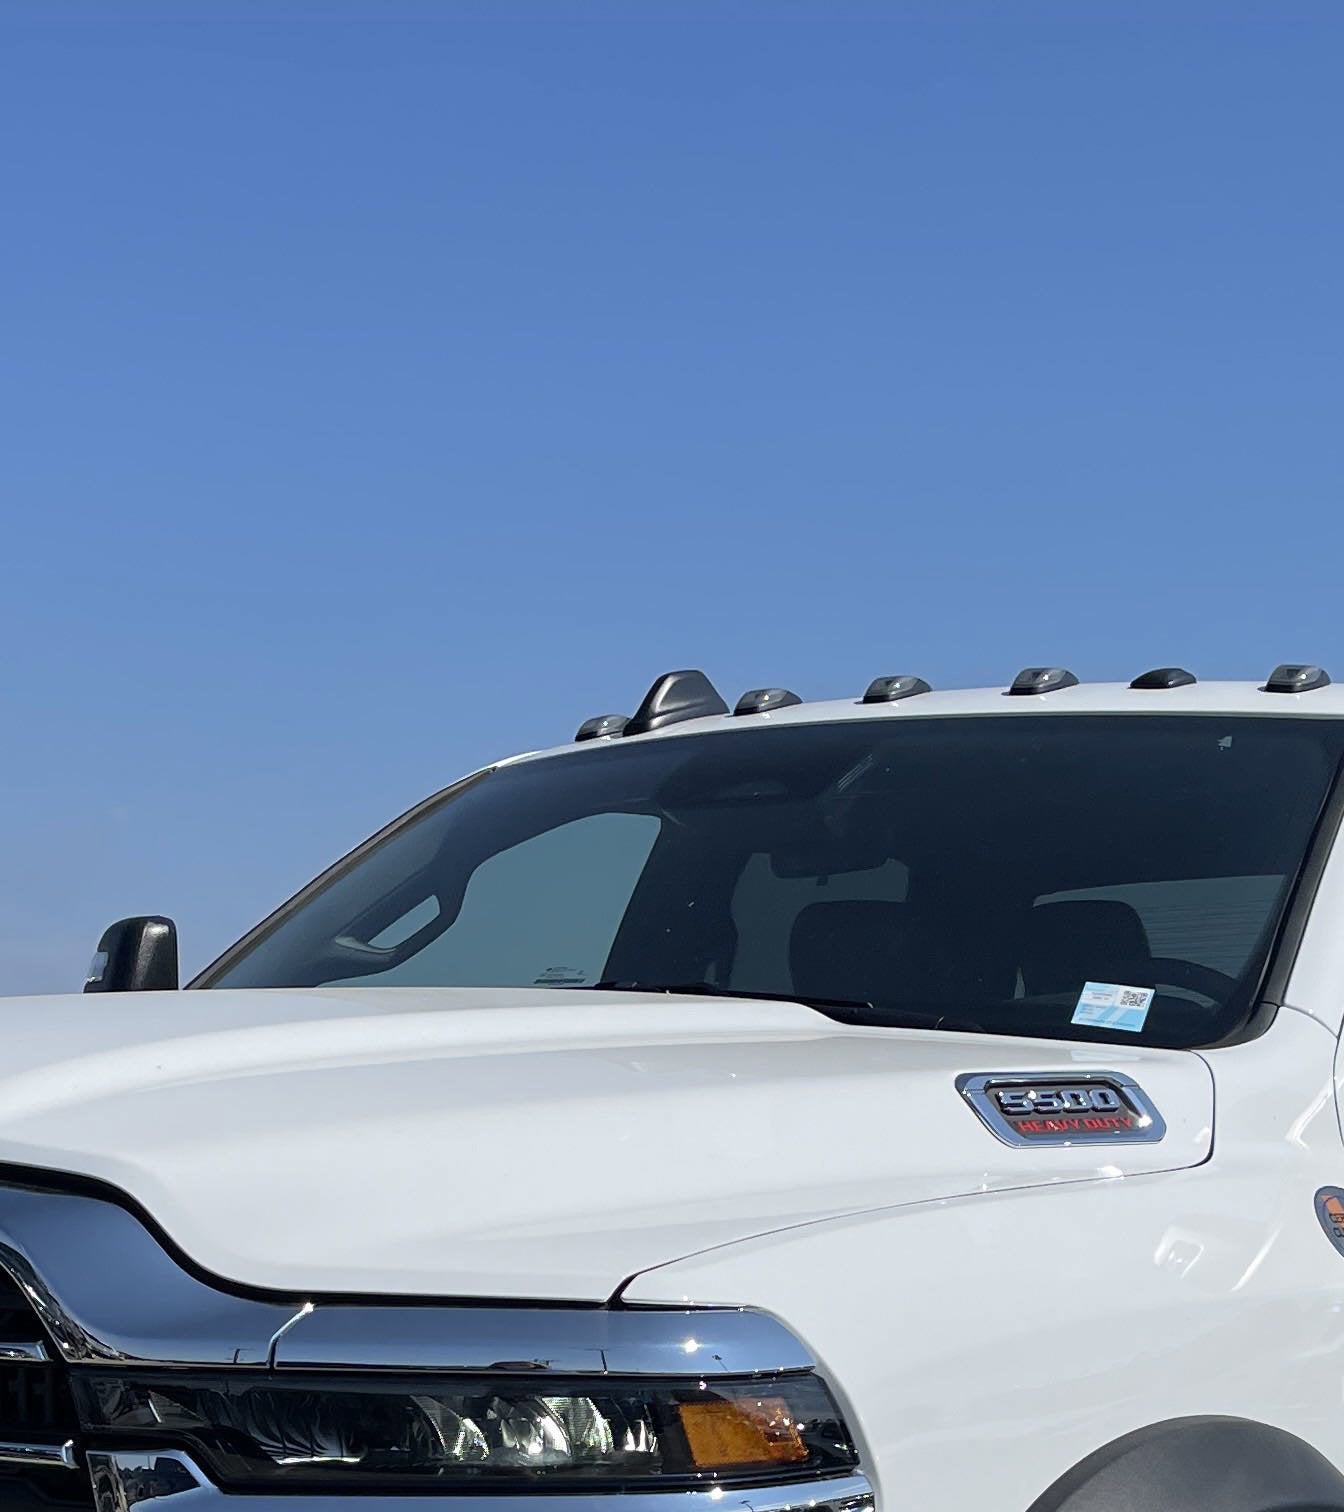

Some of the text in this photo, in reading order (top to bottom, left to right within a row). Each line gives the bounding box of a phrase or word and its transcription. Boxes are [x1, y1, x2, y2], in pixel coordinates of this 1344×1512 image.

[995, 1088, 1121, 1116] 5500
[1017, 1117, 1135, 1132] HEAVY DUTY
